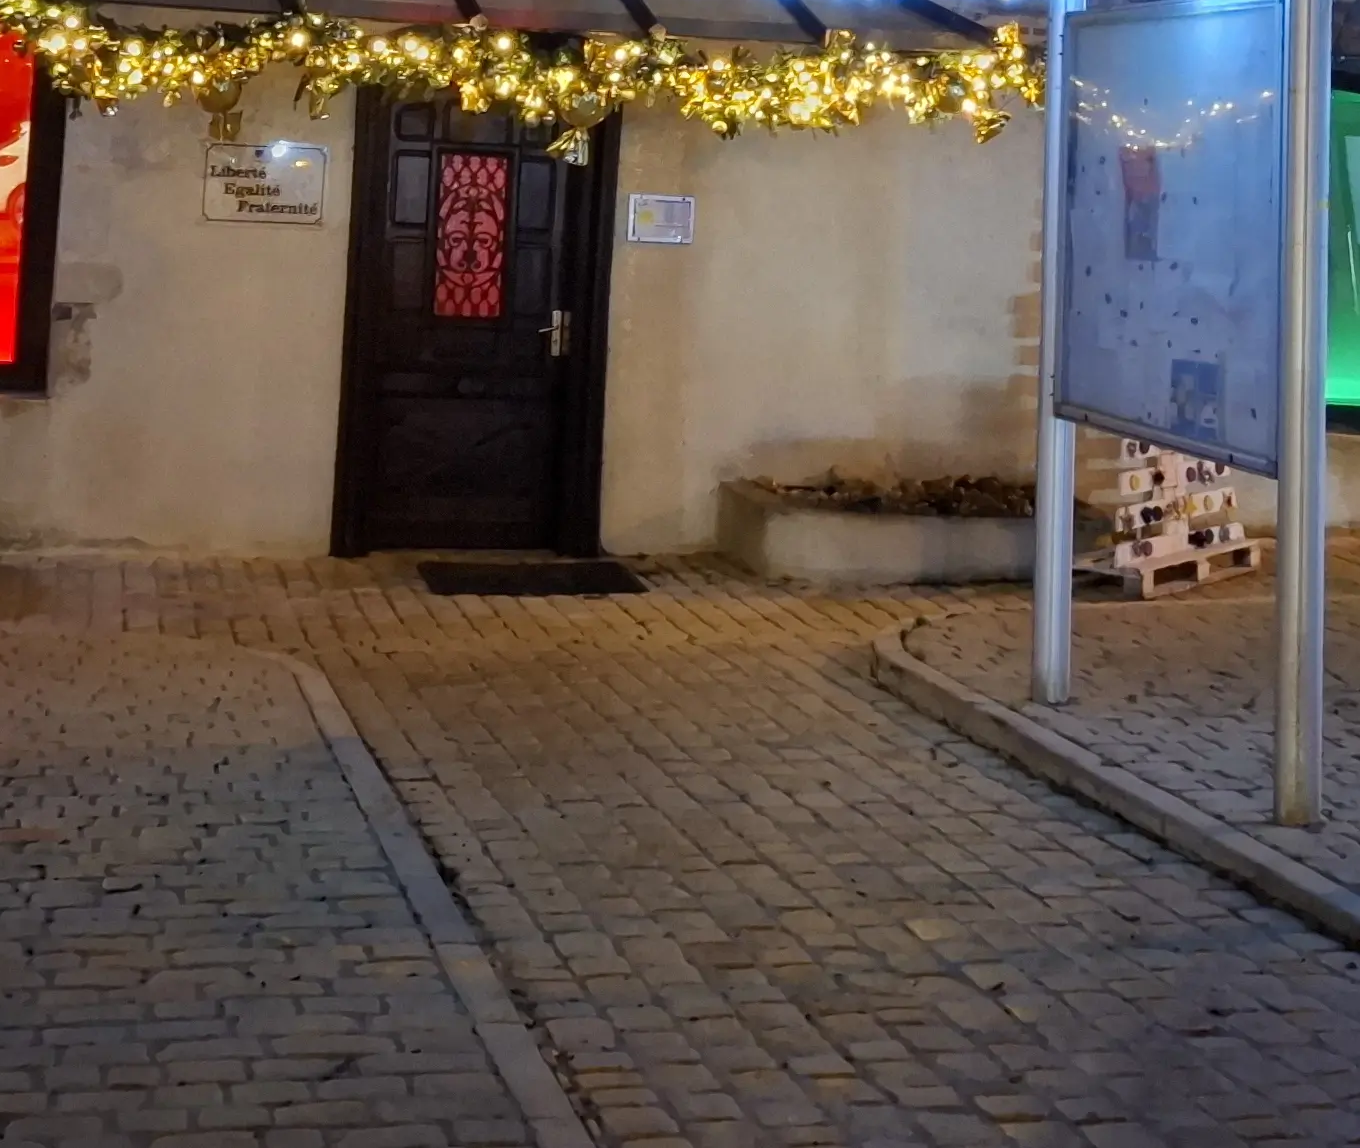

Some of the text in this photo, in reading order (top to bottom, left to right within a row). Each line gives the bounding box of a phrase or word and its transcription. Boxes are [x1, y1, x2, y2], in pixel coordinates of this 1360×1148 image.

[210, 165, 267, 180] Liberté
[223, 182, 281, 198] Egalité
[236, 200, 318, 215] Fraternité
